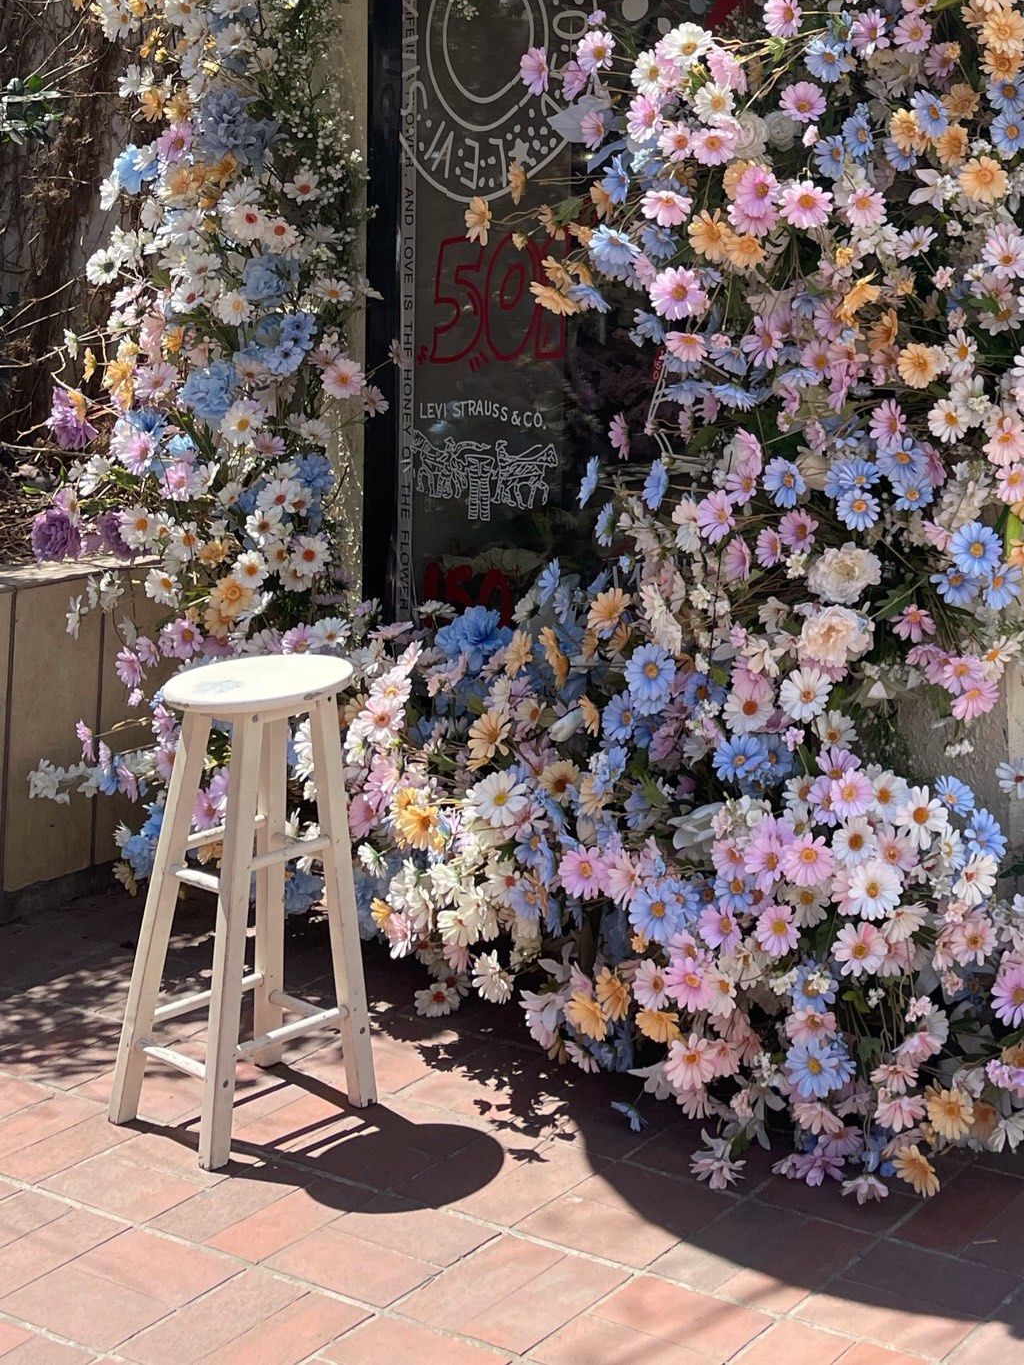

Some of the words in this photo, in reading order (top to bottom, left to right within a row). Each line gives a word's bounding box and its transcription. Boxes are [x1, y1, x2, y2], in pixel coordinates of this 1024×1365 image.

[403, 187, 415, 226] AND
[403, 236, 414, 284] LOVE
[403, 294, 413, 311] IS
[403, 322, 413, 358] THE
[402, 369, 413, 436] HONEY
[419, 401, 447, 420] LEVI
[452, 400, 509, 422] STRAUSS
[510, 410, 521, 426] &
[523, 411, 547, 431] CO.
[400, 483, 412, 519] THE
[398, 530, 411, 611] FLOWER
